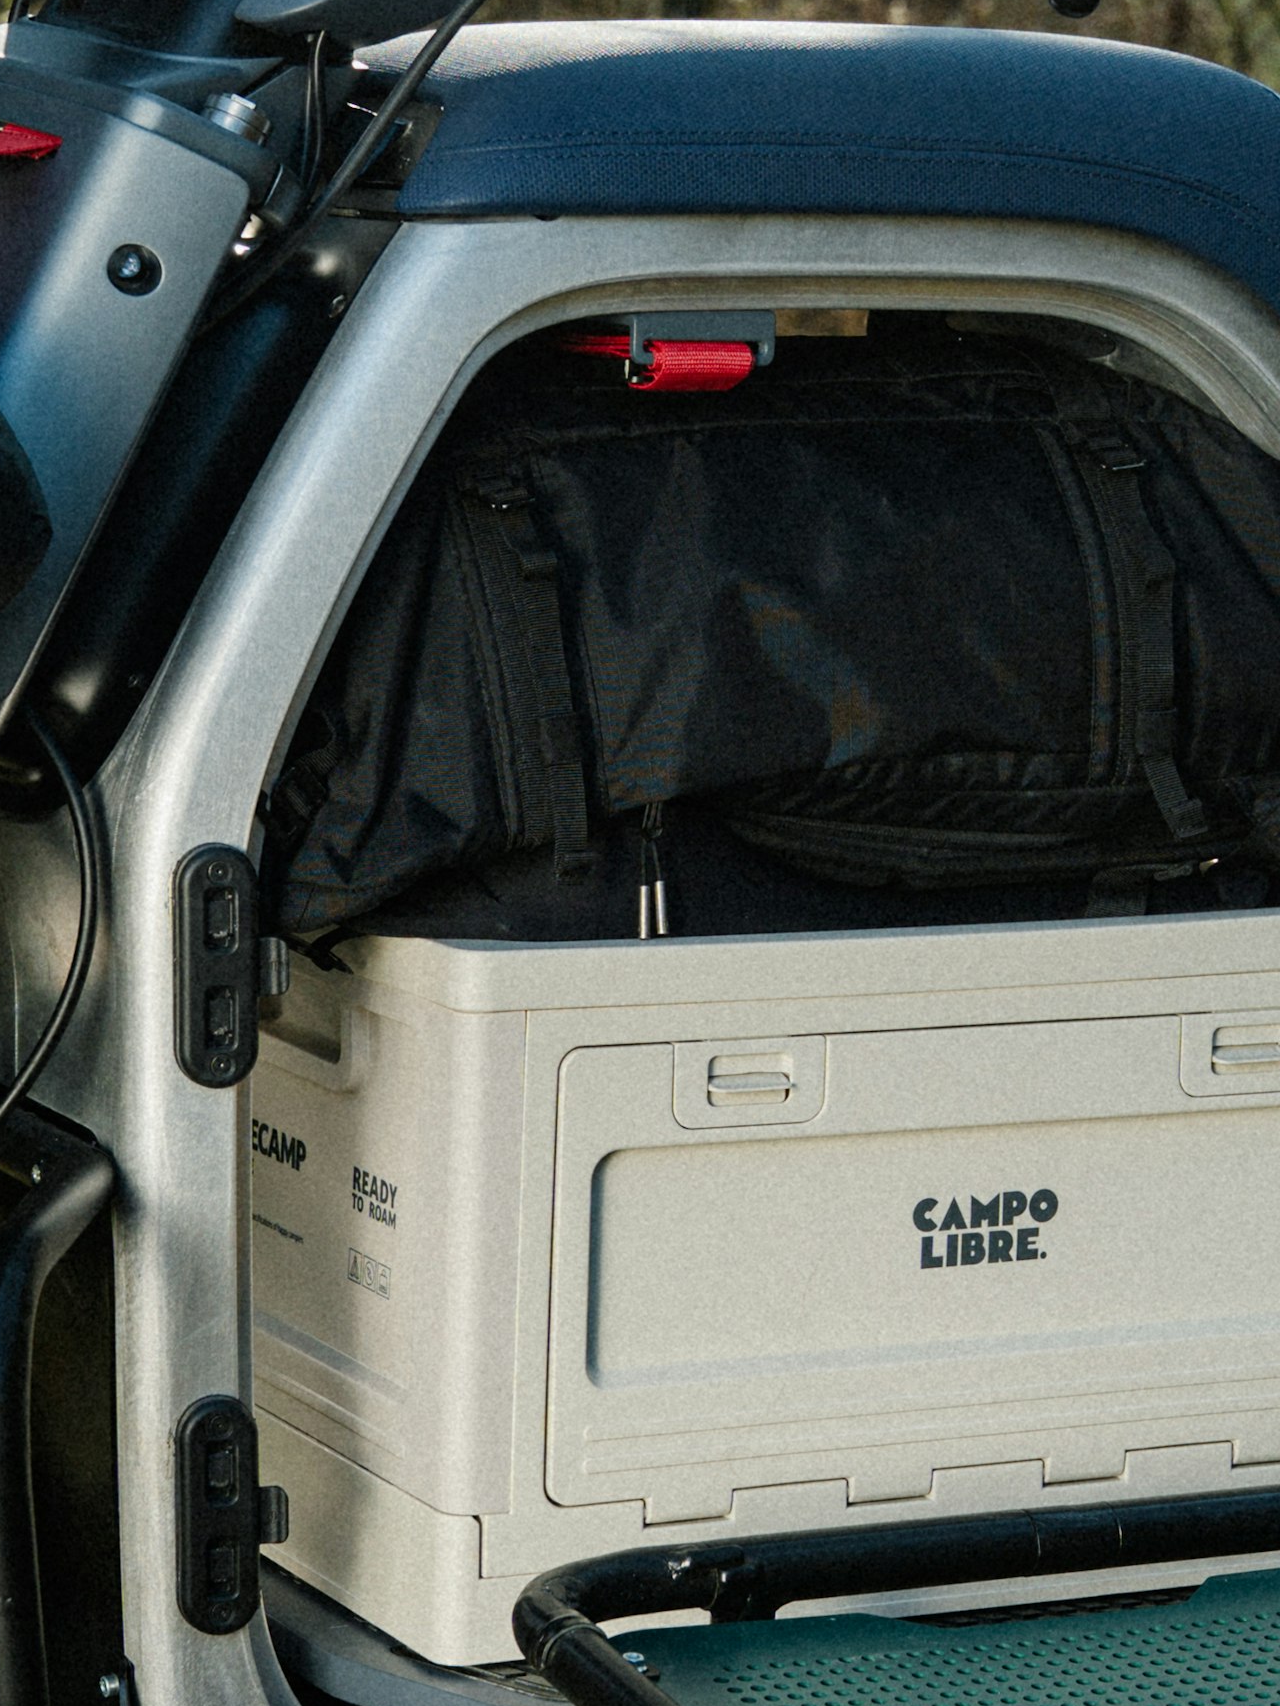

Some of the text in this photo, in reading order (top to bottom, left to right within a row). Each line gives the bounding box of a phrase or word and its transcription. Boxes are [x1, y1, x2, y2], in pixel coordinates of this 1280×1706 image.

[352, 1166, 398, 1209] READY
[351, 1193, 397, 1230] TO ROAM
[912, 1188, 1059, 1233] CAMPO
[920, 1226, 1047, 1270] LIBRE.
